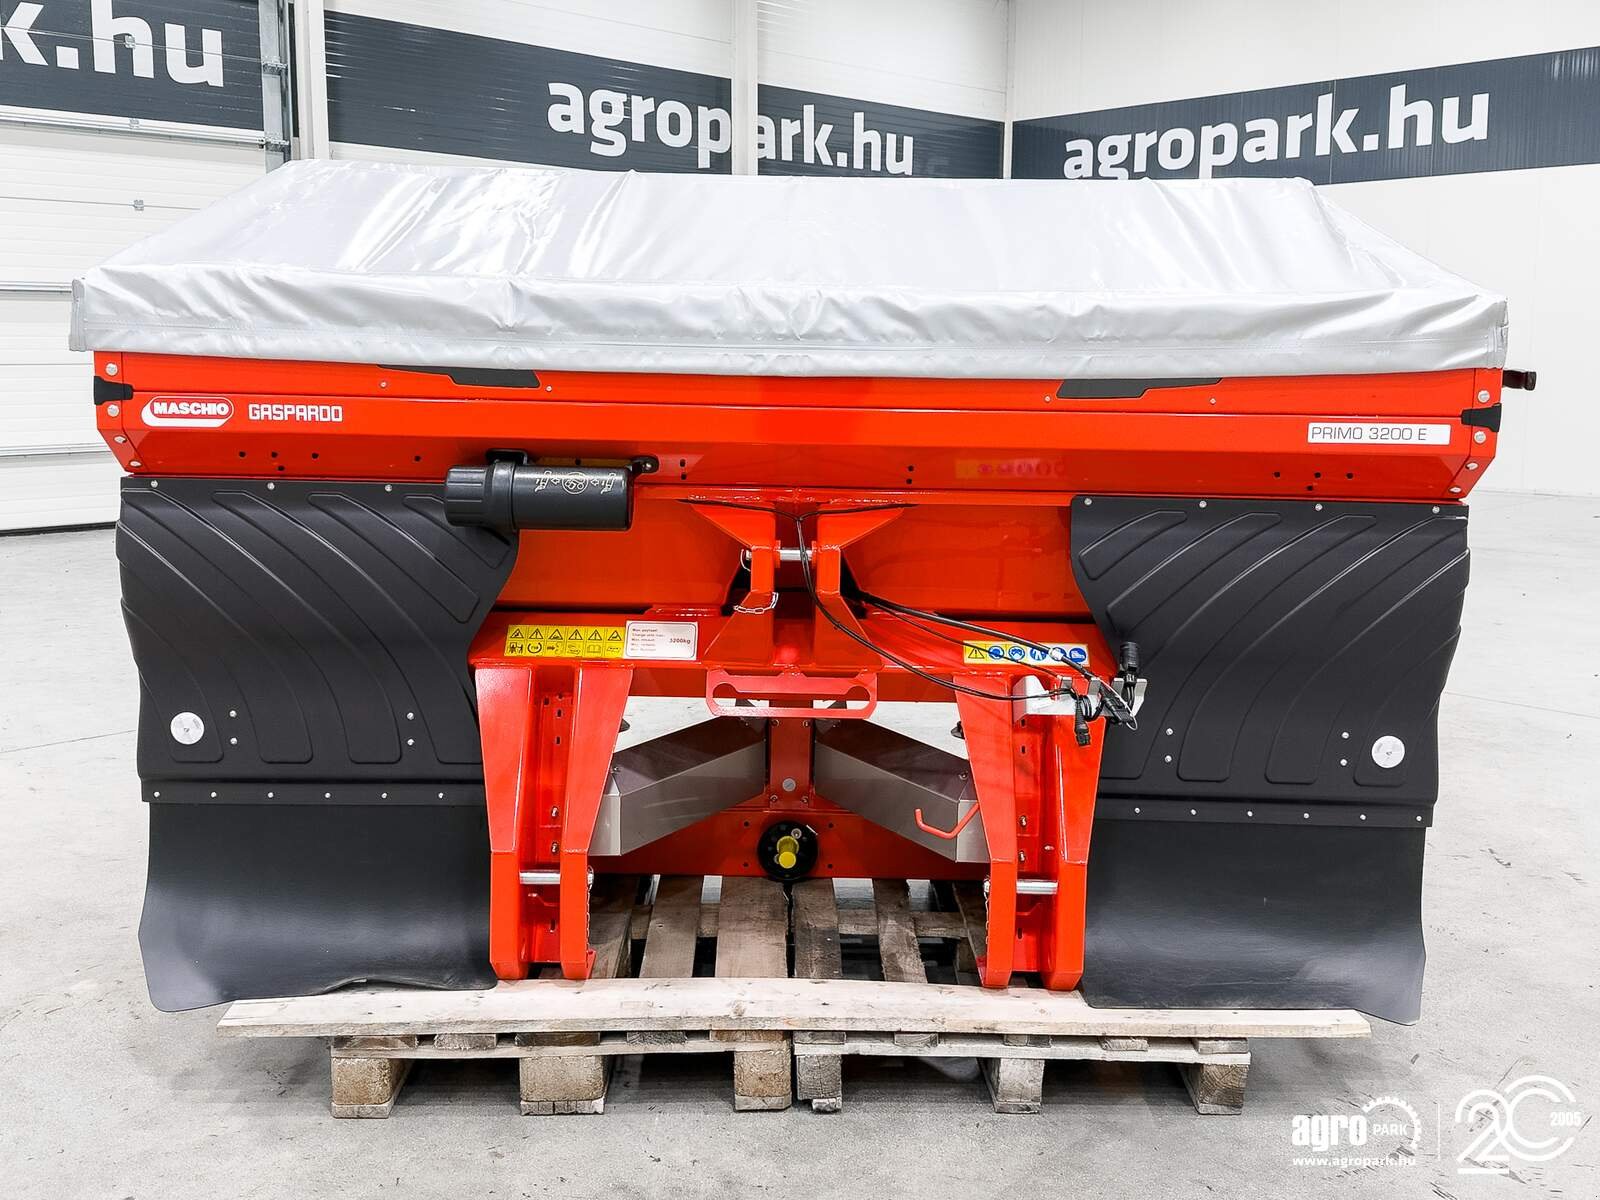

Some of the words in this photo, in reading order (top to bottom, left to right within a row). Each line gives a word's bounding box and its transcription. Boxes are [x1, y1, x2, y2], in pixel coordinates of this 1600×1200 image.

[1063, 84, 1491, 181] agropark.hu
[153, 401, 230, 416] MASCHIO
[248, 403, 343, 422] GASPARDO
[1311, 426, 1363, 440] PRIMO
[1368, 427, 1413, 441] 3200
[1418, 428, 1428, 441] E
